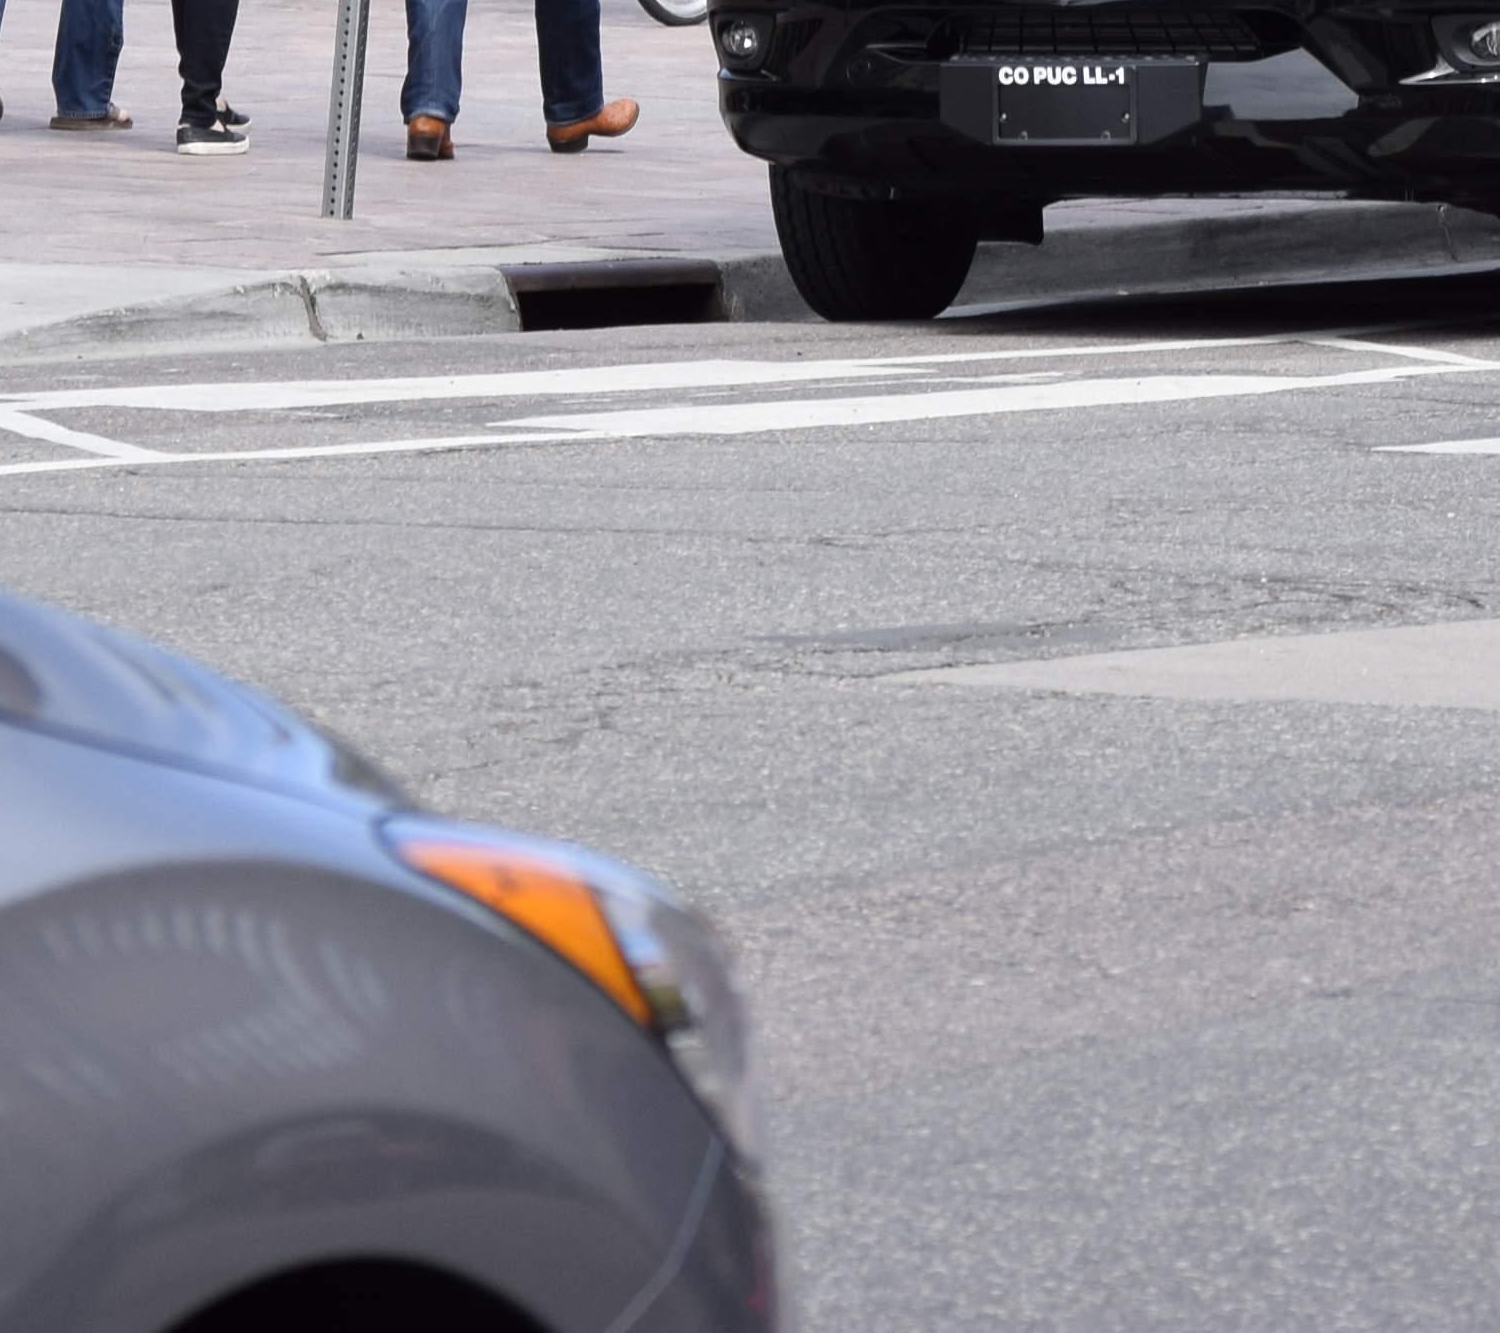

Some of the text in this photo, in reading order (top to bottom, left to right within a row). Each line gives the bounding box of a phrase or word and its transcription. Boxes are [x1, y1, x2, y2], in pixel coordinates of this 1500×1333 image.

[998, 66, 1125, 85] CO PUC LL-1
